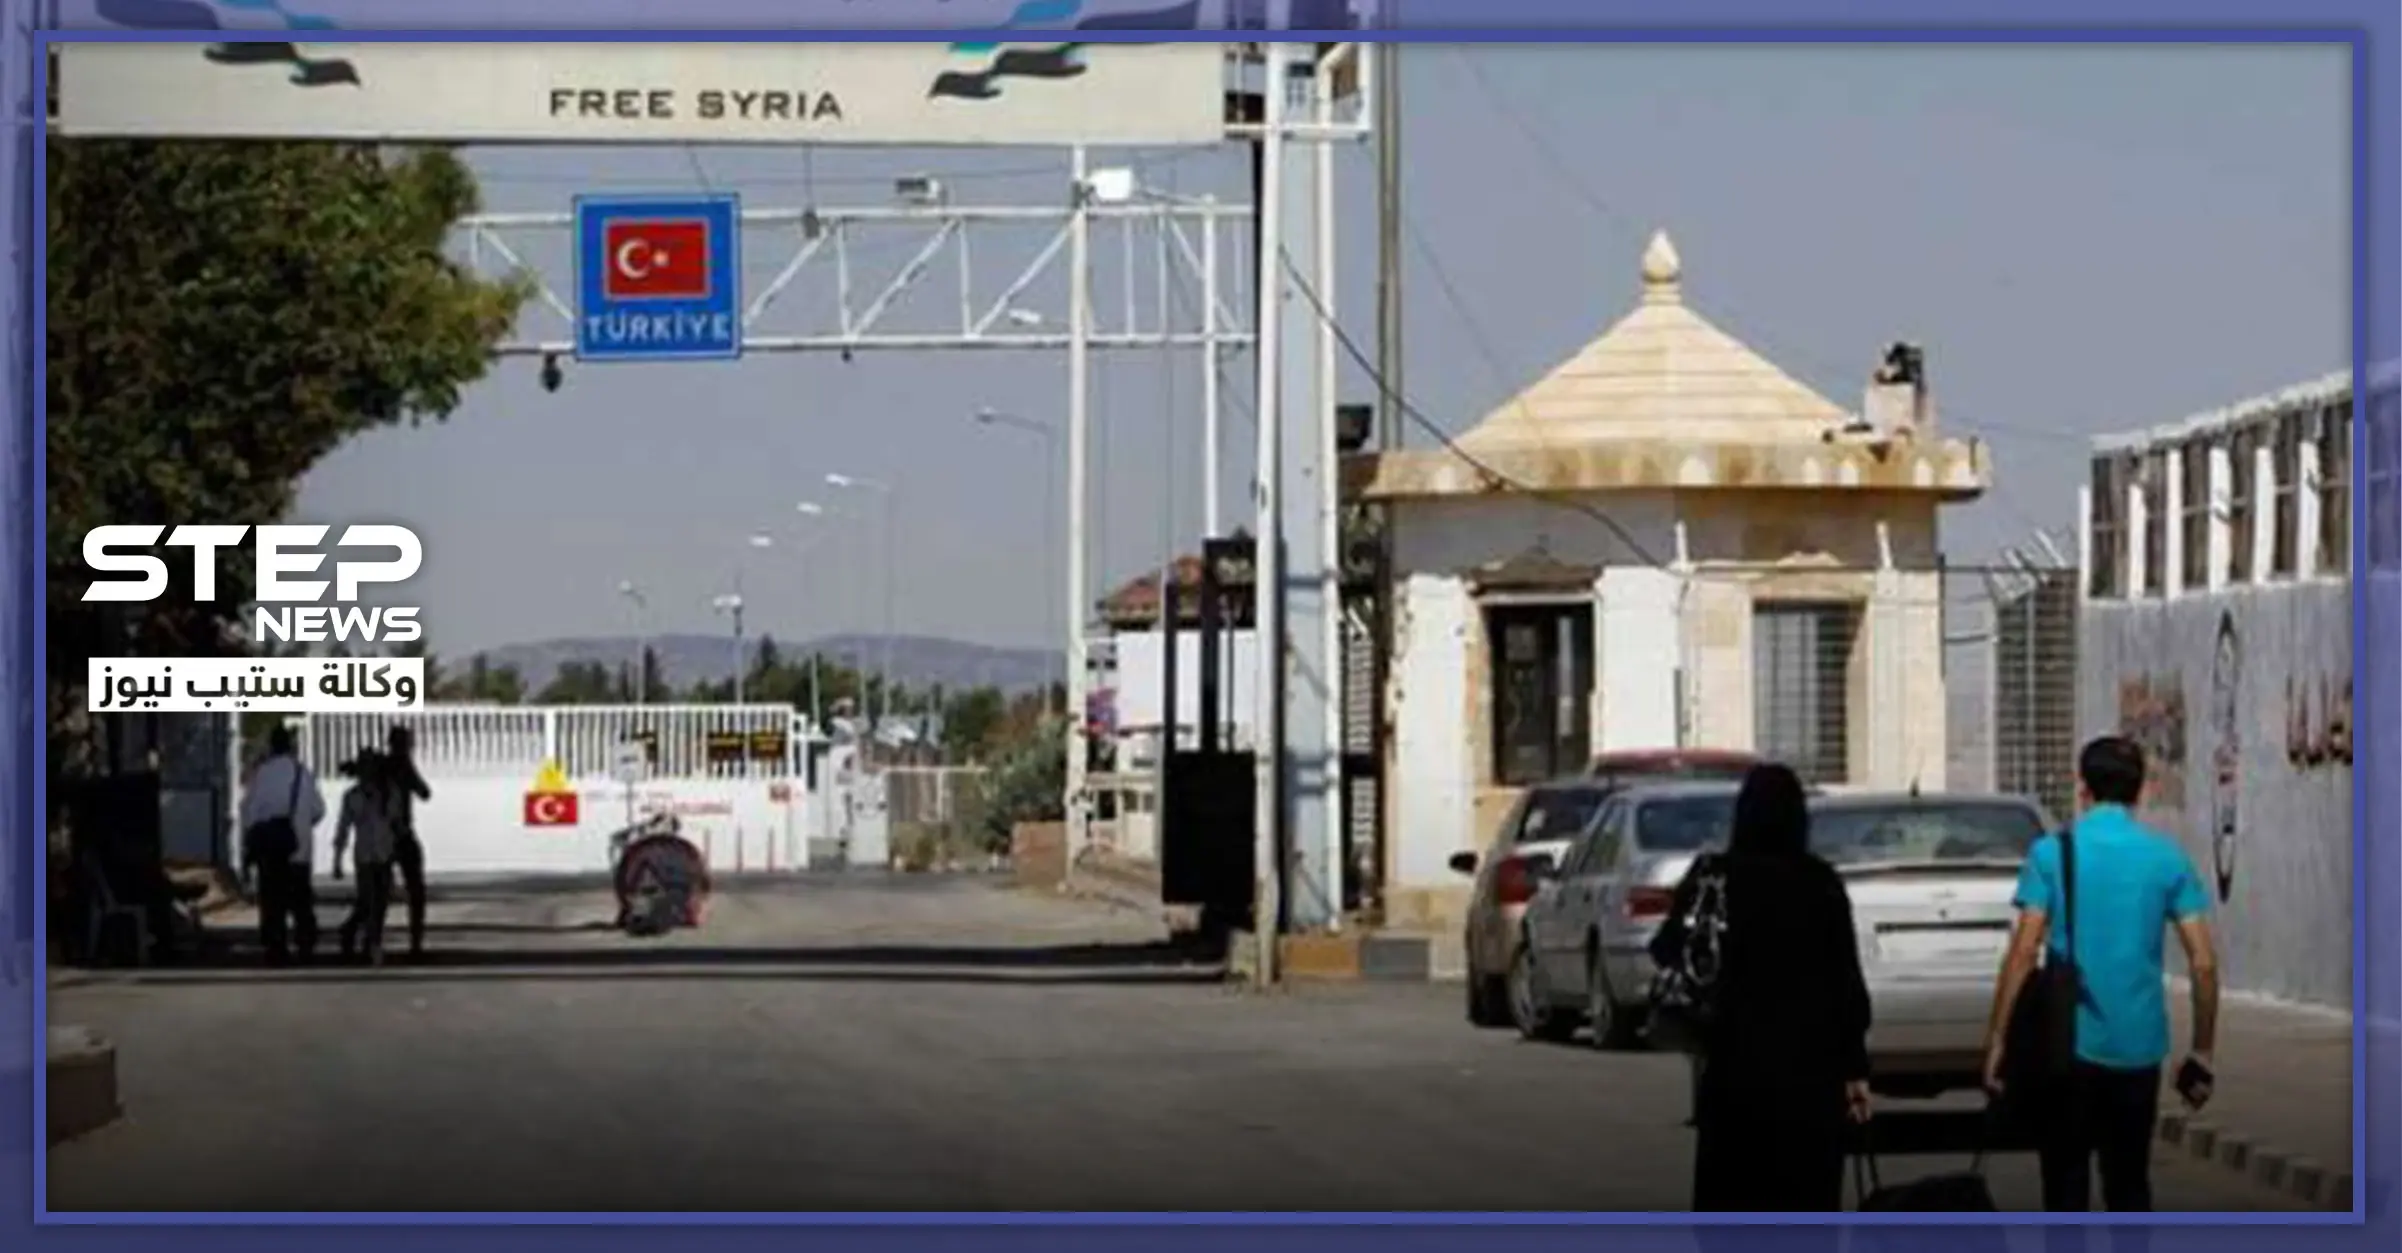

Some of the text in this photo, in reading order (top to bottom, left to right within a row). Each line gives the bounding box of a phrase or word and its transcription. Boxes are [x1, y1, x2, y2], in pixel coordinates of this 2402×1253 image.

[549, 89, 843, 120] FREE SYRIA
[586, 308, 731, 342] TÜRKİYE
